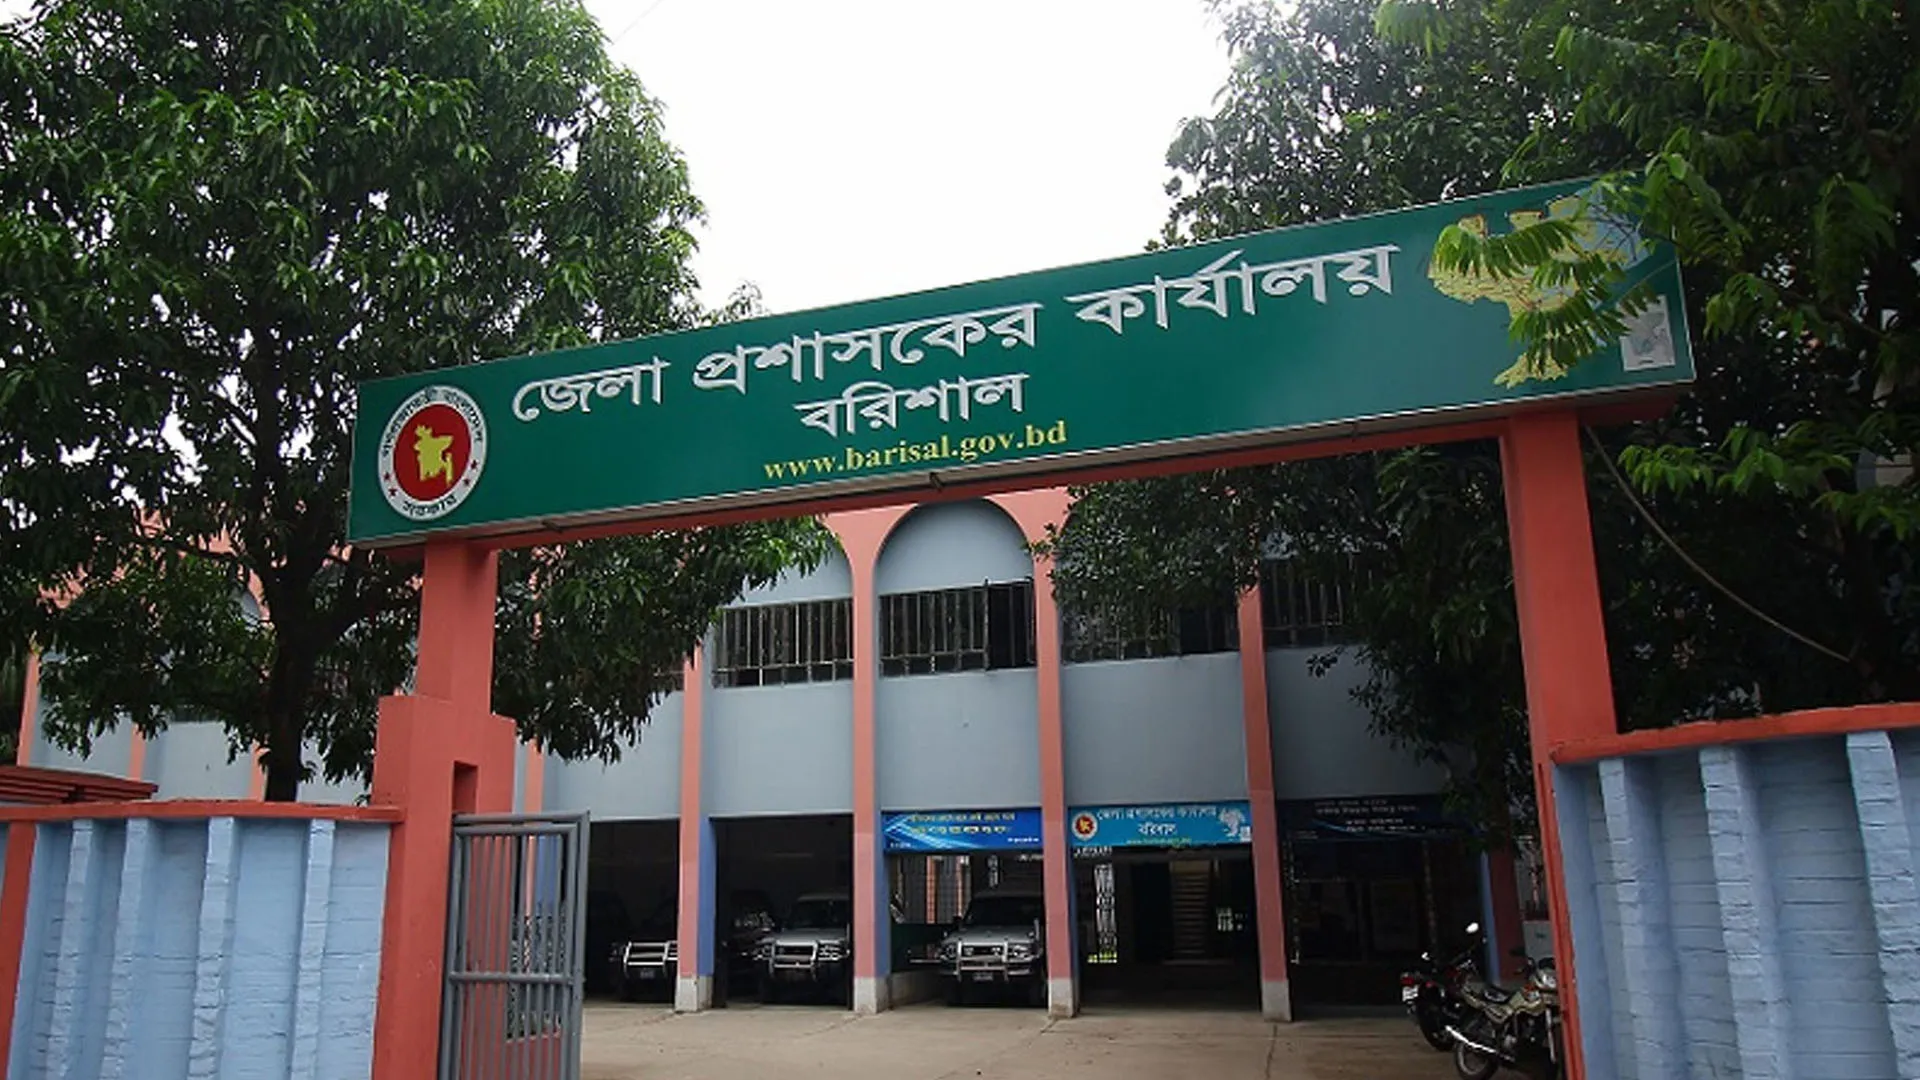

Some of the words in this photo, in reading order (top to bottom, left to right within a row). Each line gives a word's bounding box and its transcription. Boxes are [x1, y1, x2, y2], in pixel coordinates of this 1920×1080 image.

[512, 357, 670, 421] জেলা
[693, 303, 1043, 393] প্রশাসকের
[1064, 243, 1400, 334] কার্যালয়
[793, 371, 1030, 436] বরিশাল
[763, 421, 1067, 480] www.barisal.gov.bd
